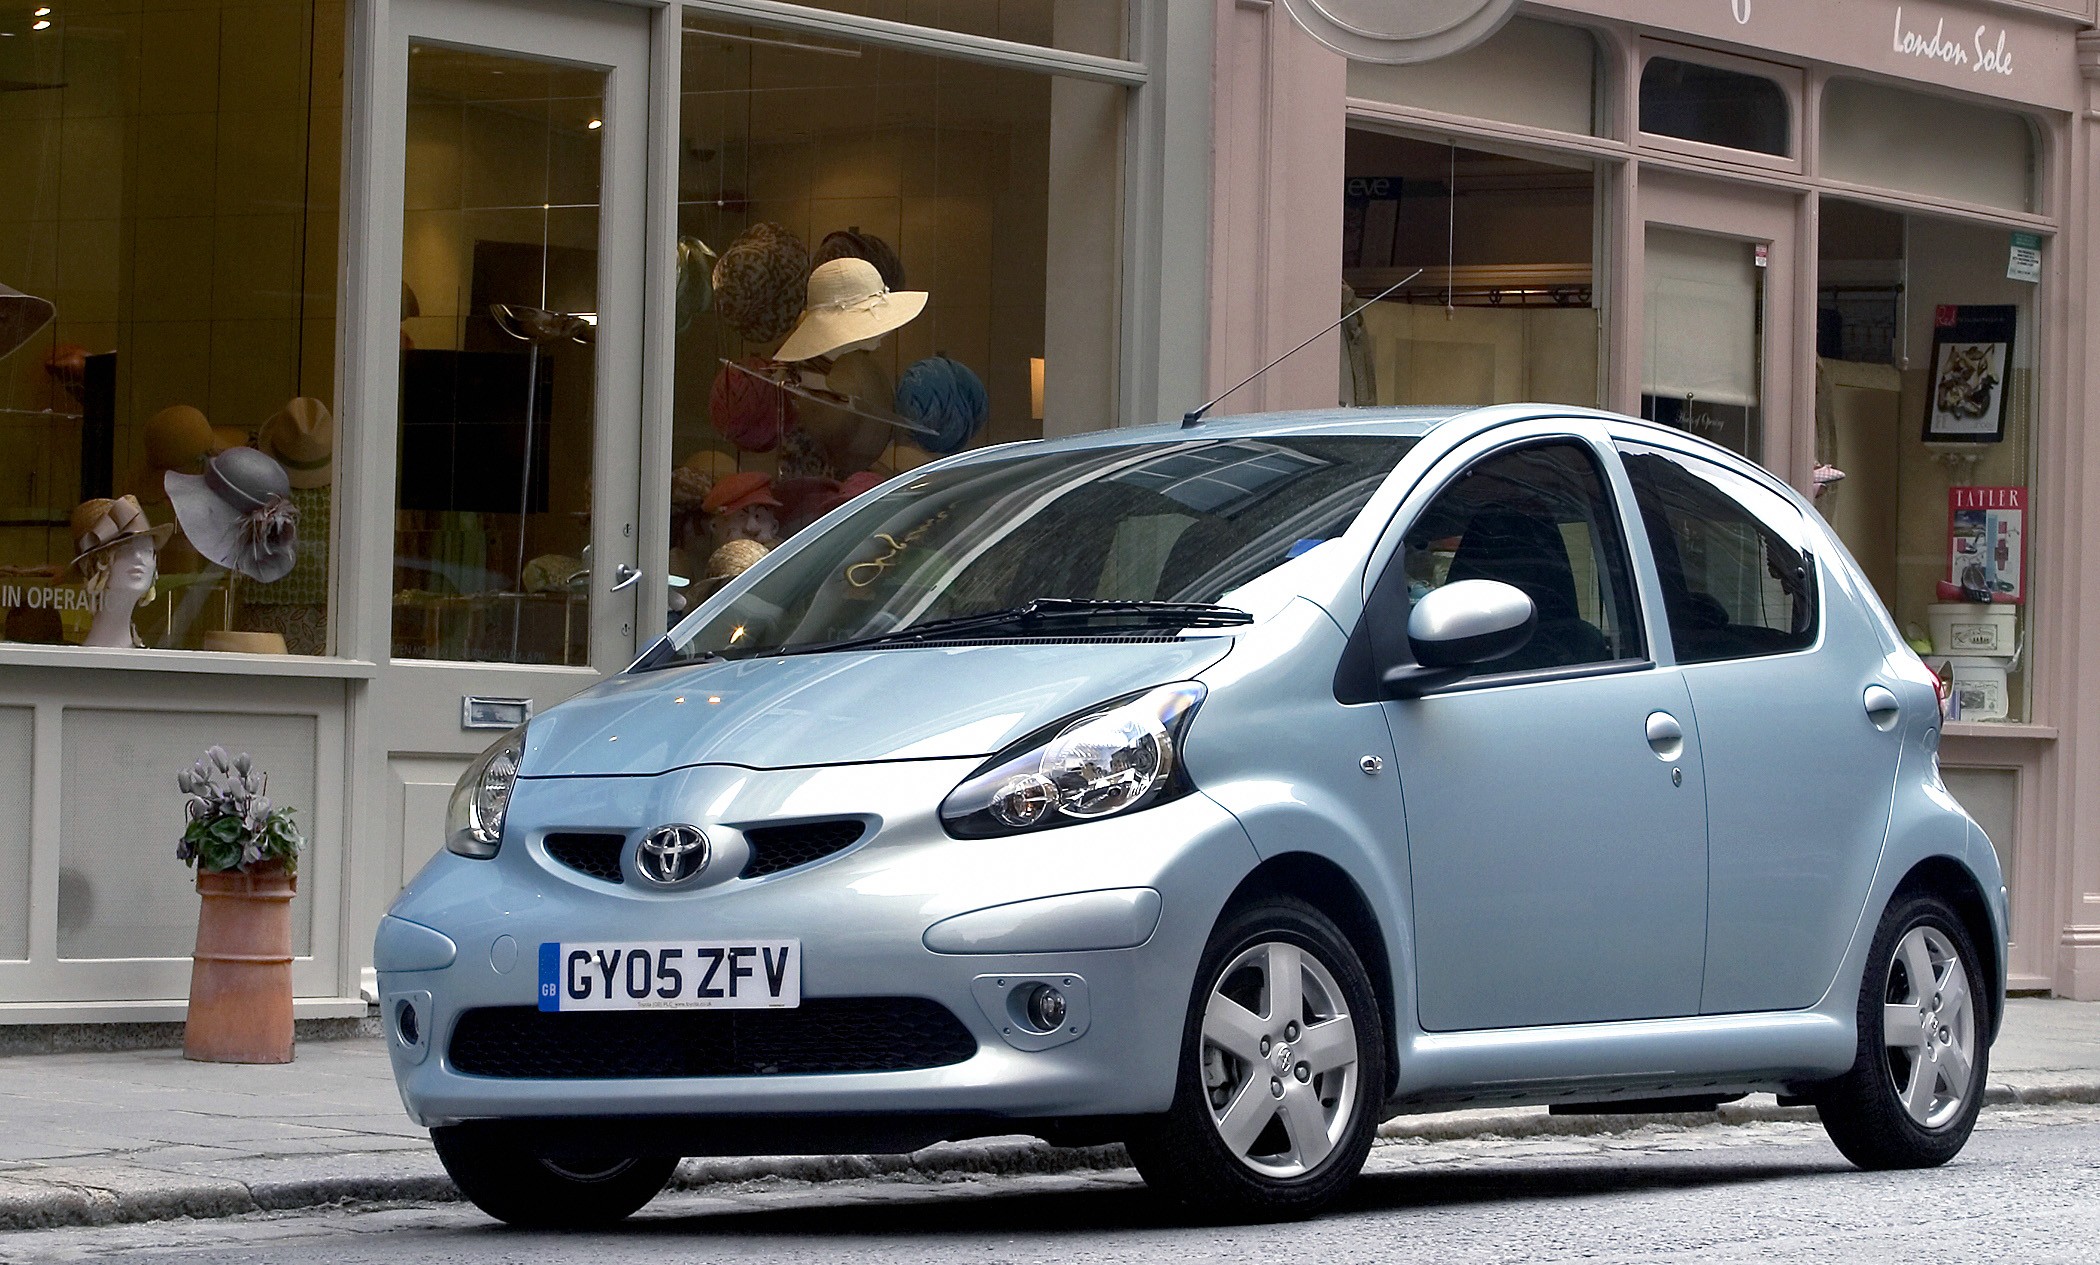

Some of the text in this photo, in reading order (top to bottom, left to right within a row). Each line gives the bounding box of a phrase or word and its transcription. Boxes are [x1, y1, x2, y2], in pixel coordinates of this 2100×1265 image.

[1893, 6, 2013, 75] London Sole
[1348, 178, 1390, 196] eve
[1956, 489, 2019, 507] TATLER
[2, 585, 118, 612] IN OPERATI
[567, 946, 789, 999] GY05 ZFV
[542, 983, 556, 996] GB
